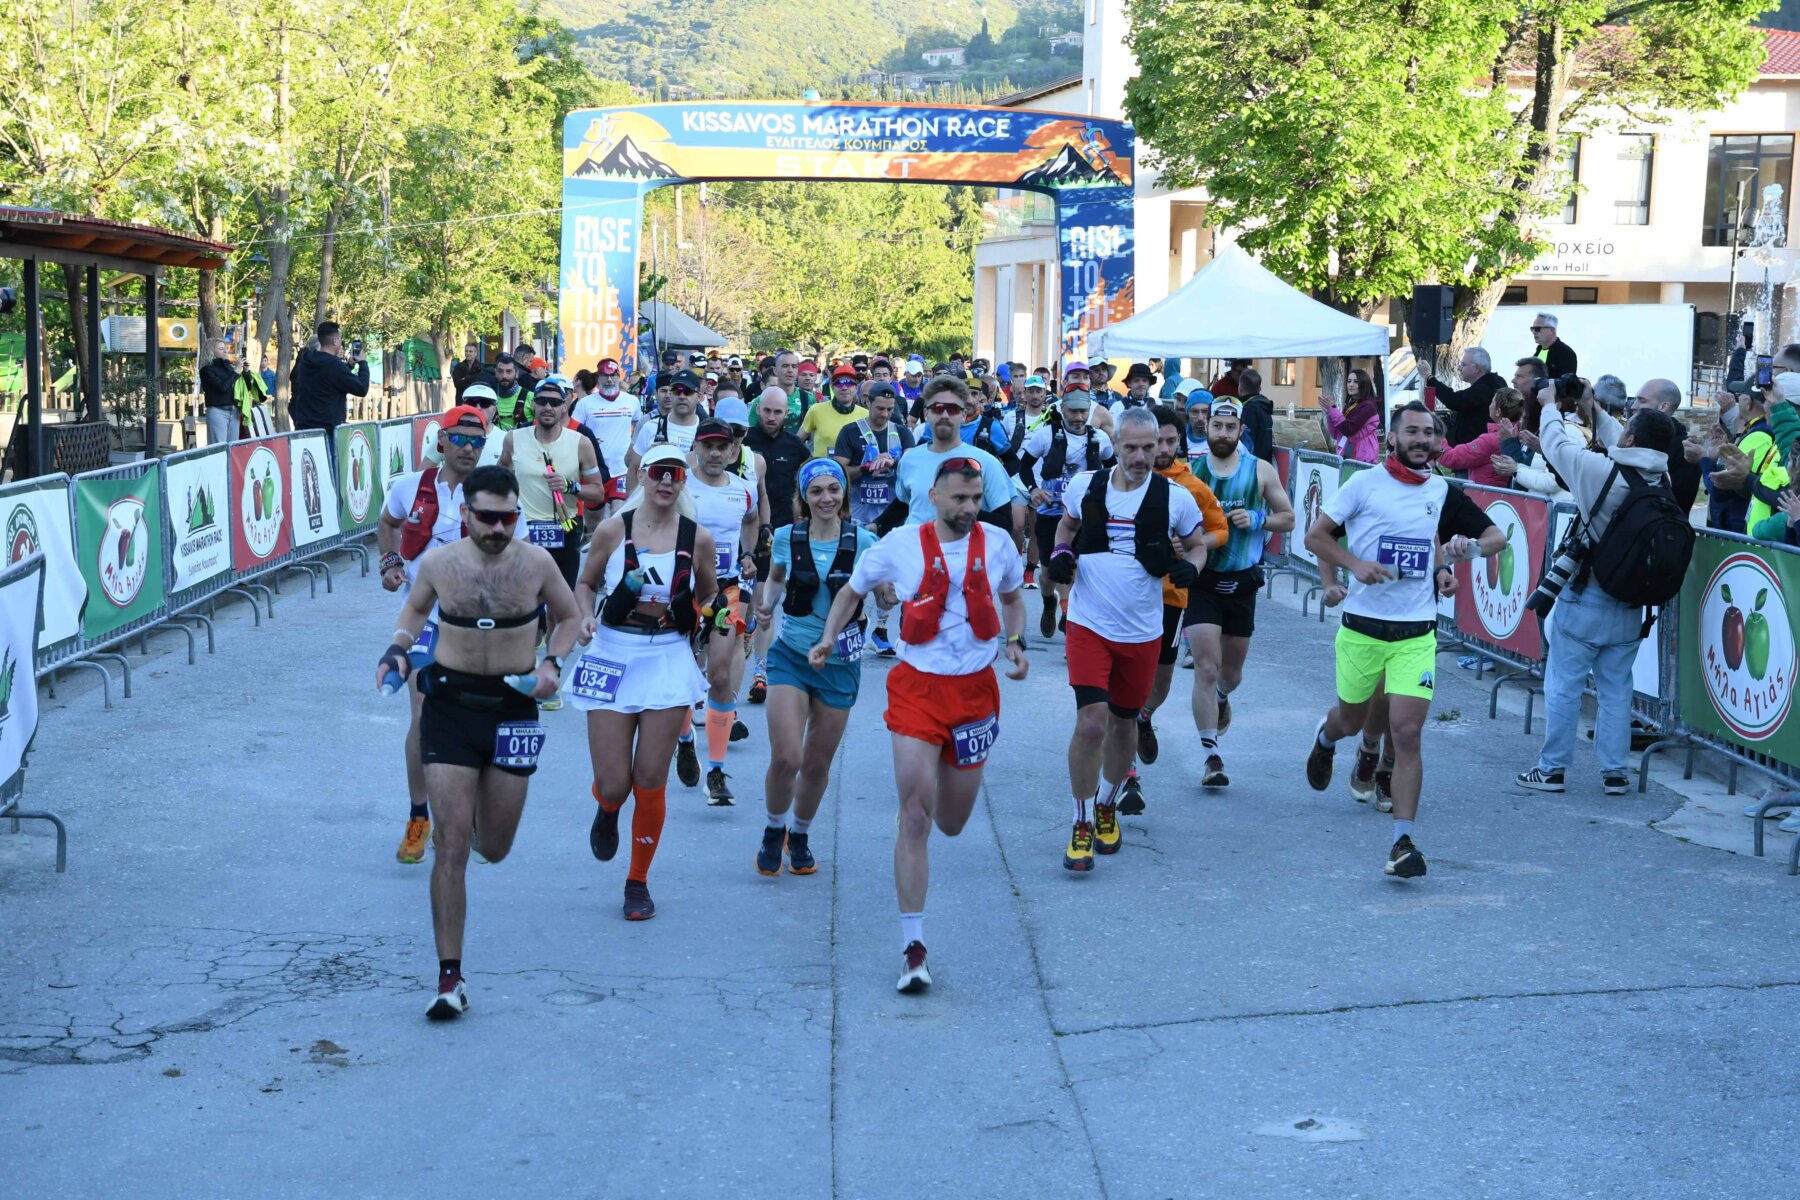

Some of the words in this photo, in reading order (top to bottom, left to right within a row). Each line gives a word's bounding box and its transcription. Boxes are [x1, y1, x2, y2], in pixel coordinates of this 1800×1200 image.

[682, 111, 796, 134] KISSAVOS
[803, 114, 939, 137] MARATHON
[947, 117, 1010, 138] RACE
[766, 136, 840, 150] ΕΥΑΓΓΕΛΟΣ
[844, 138, 928, 150] ΚΟΥΜΠΑΡΟΣ
[775, 155, 919, 179] START
[574, 215, 632, 252] RISE
[1071, 225, 1126, 259] RISE
[573, 252, 604, 286] TO
[1069, 261, 1099, 294] TO
[1565, 262, 1589, 272] Hall
[571, 288, 618, 321] THE
[571, 322, 617, 356] TOP
[866, 488, 884, 498] 017
[534, 530, 556, 540] 133
[1392, 551, 1419, 568] 121
[1476, 570, 1493, 618] Μήλα
[1496, 584, 1521, 628] Αγιάς
[847, 632, 862, 653] 049
[580, 669, 608, 689] 034
[1708, 643, 1737, 708] Μήλα
[1744, 666, 1784, 720] Αγιάς
[510, 736, 539, 754] 016
[968, 730, 994, 754] 070
